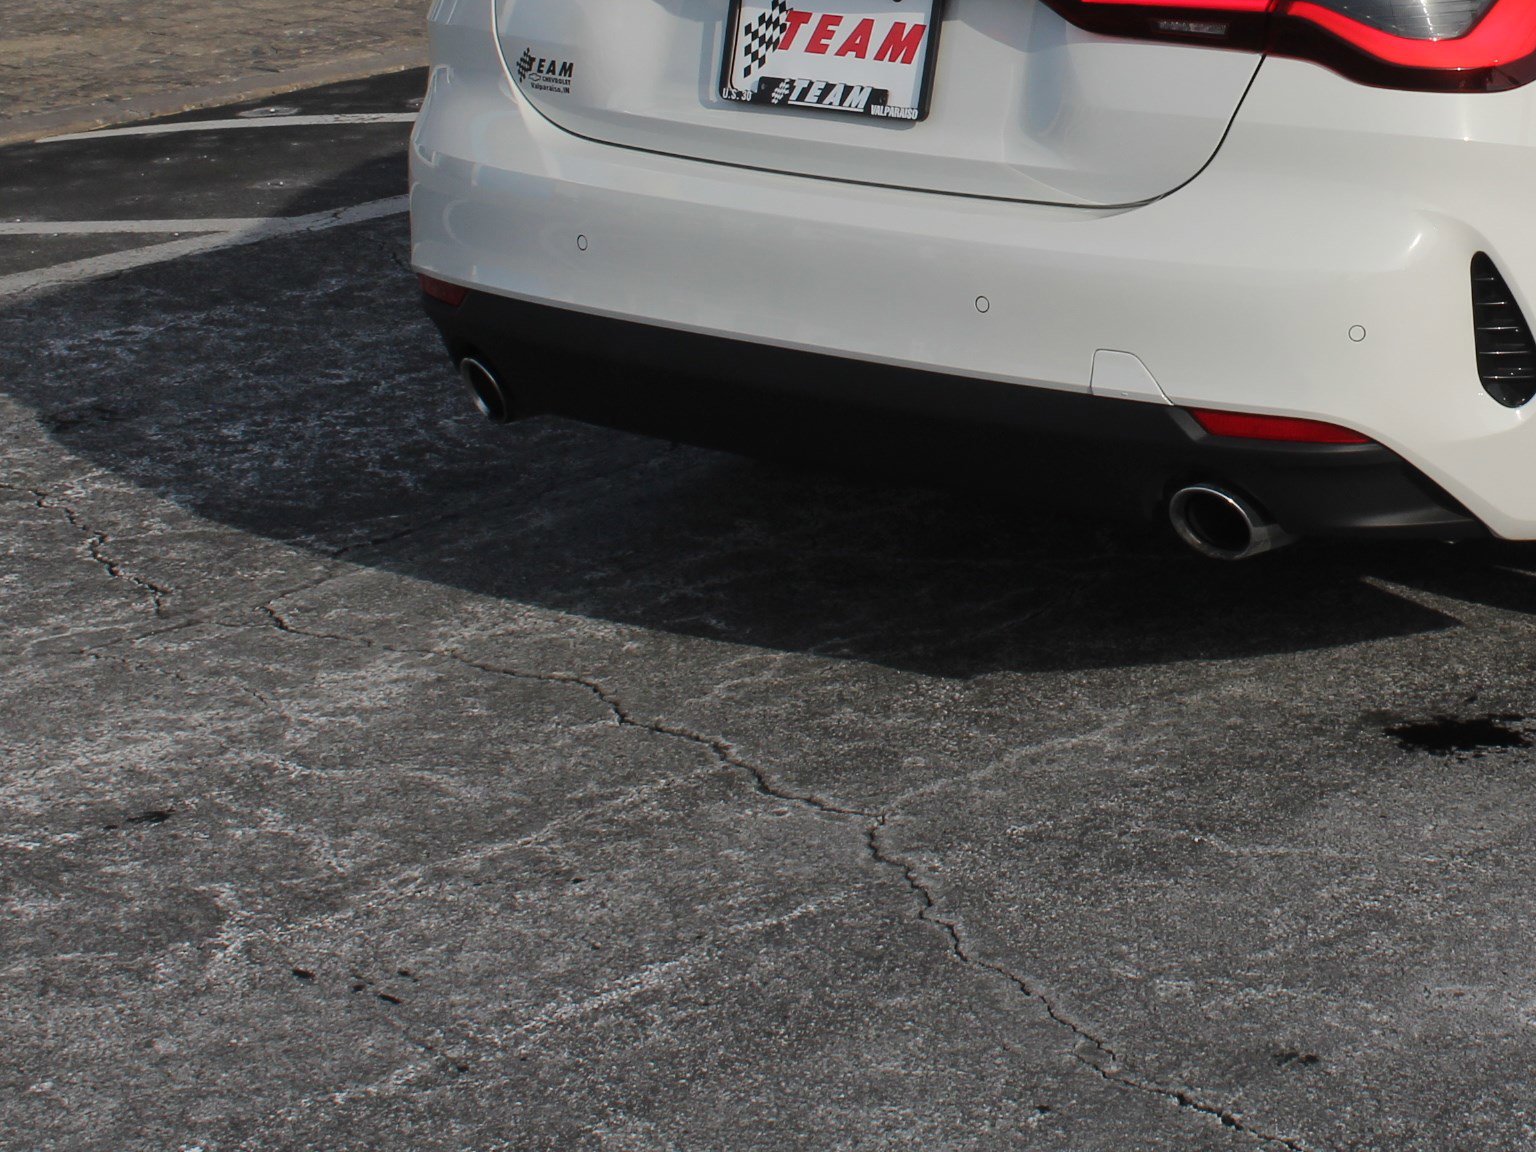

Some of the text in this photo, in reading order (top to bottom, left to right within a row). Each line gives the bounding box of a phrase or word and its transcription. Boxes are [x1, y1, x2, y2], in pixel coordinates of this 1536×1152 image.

[778, 10, 927, 64] TEAM
[528, 56, 574, 78] TEAM
[722, 87, 752, 102] U.S. 30
[788, 78, 873, 109] TEAM
[870, 104, 919, 120] VALPARAISO
